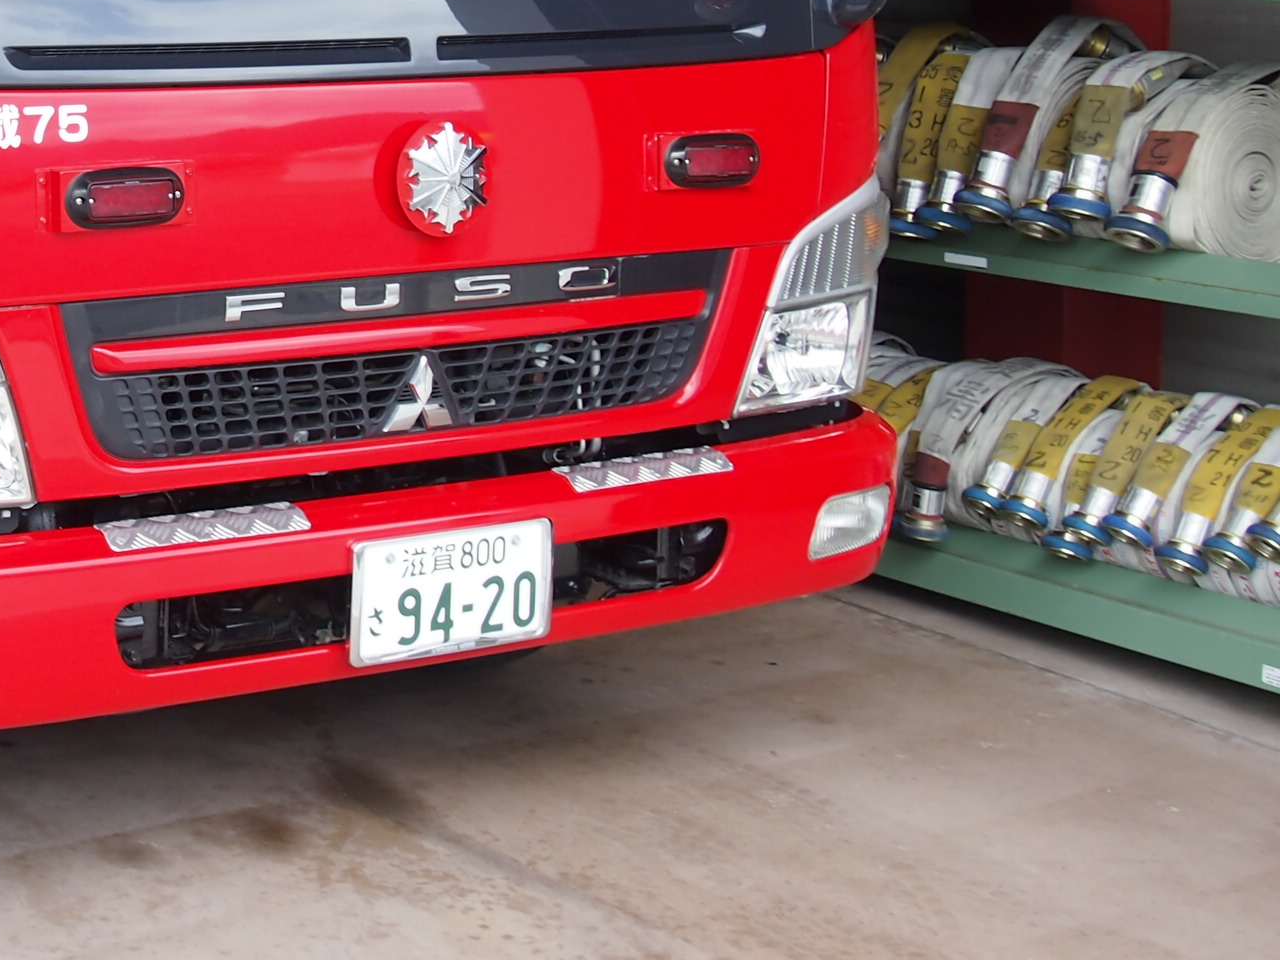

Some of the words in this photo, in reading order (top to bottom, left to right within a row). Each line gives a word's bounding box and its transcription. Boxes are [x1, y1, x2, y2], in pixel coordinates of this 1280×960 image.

[225, 265, 617, 323] FUSO
[368, 607, 383, 637] さ
[398, 570, 536, 646] 94-20
